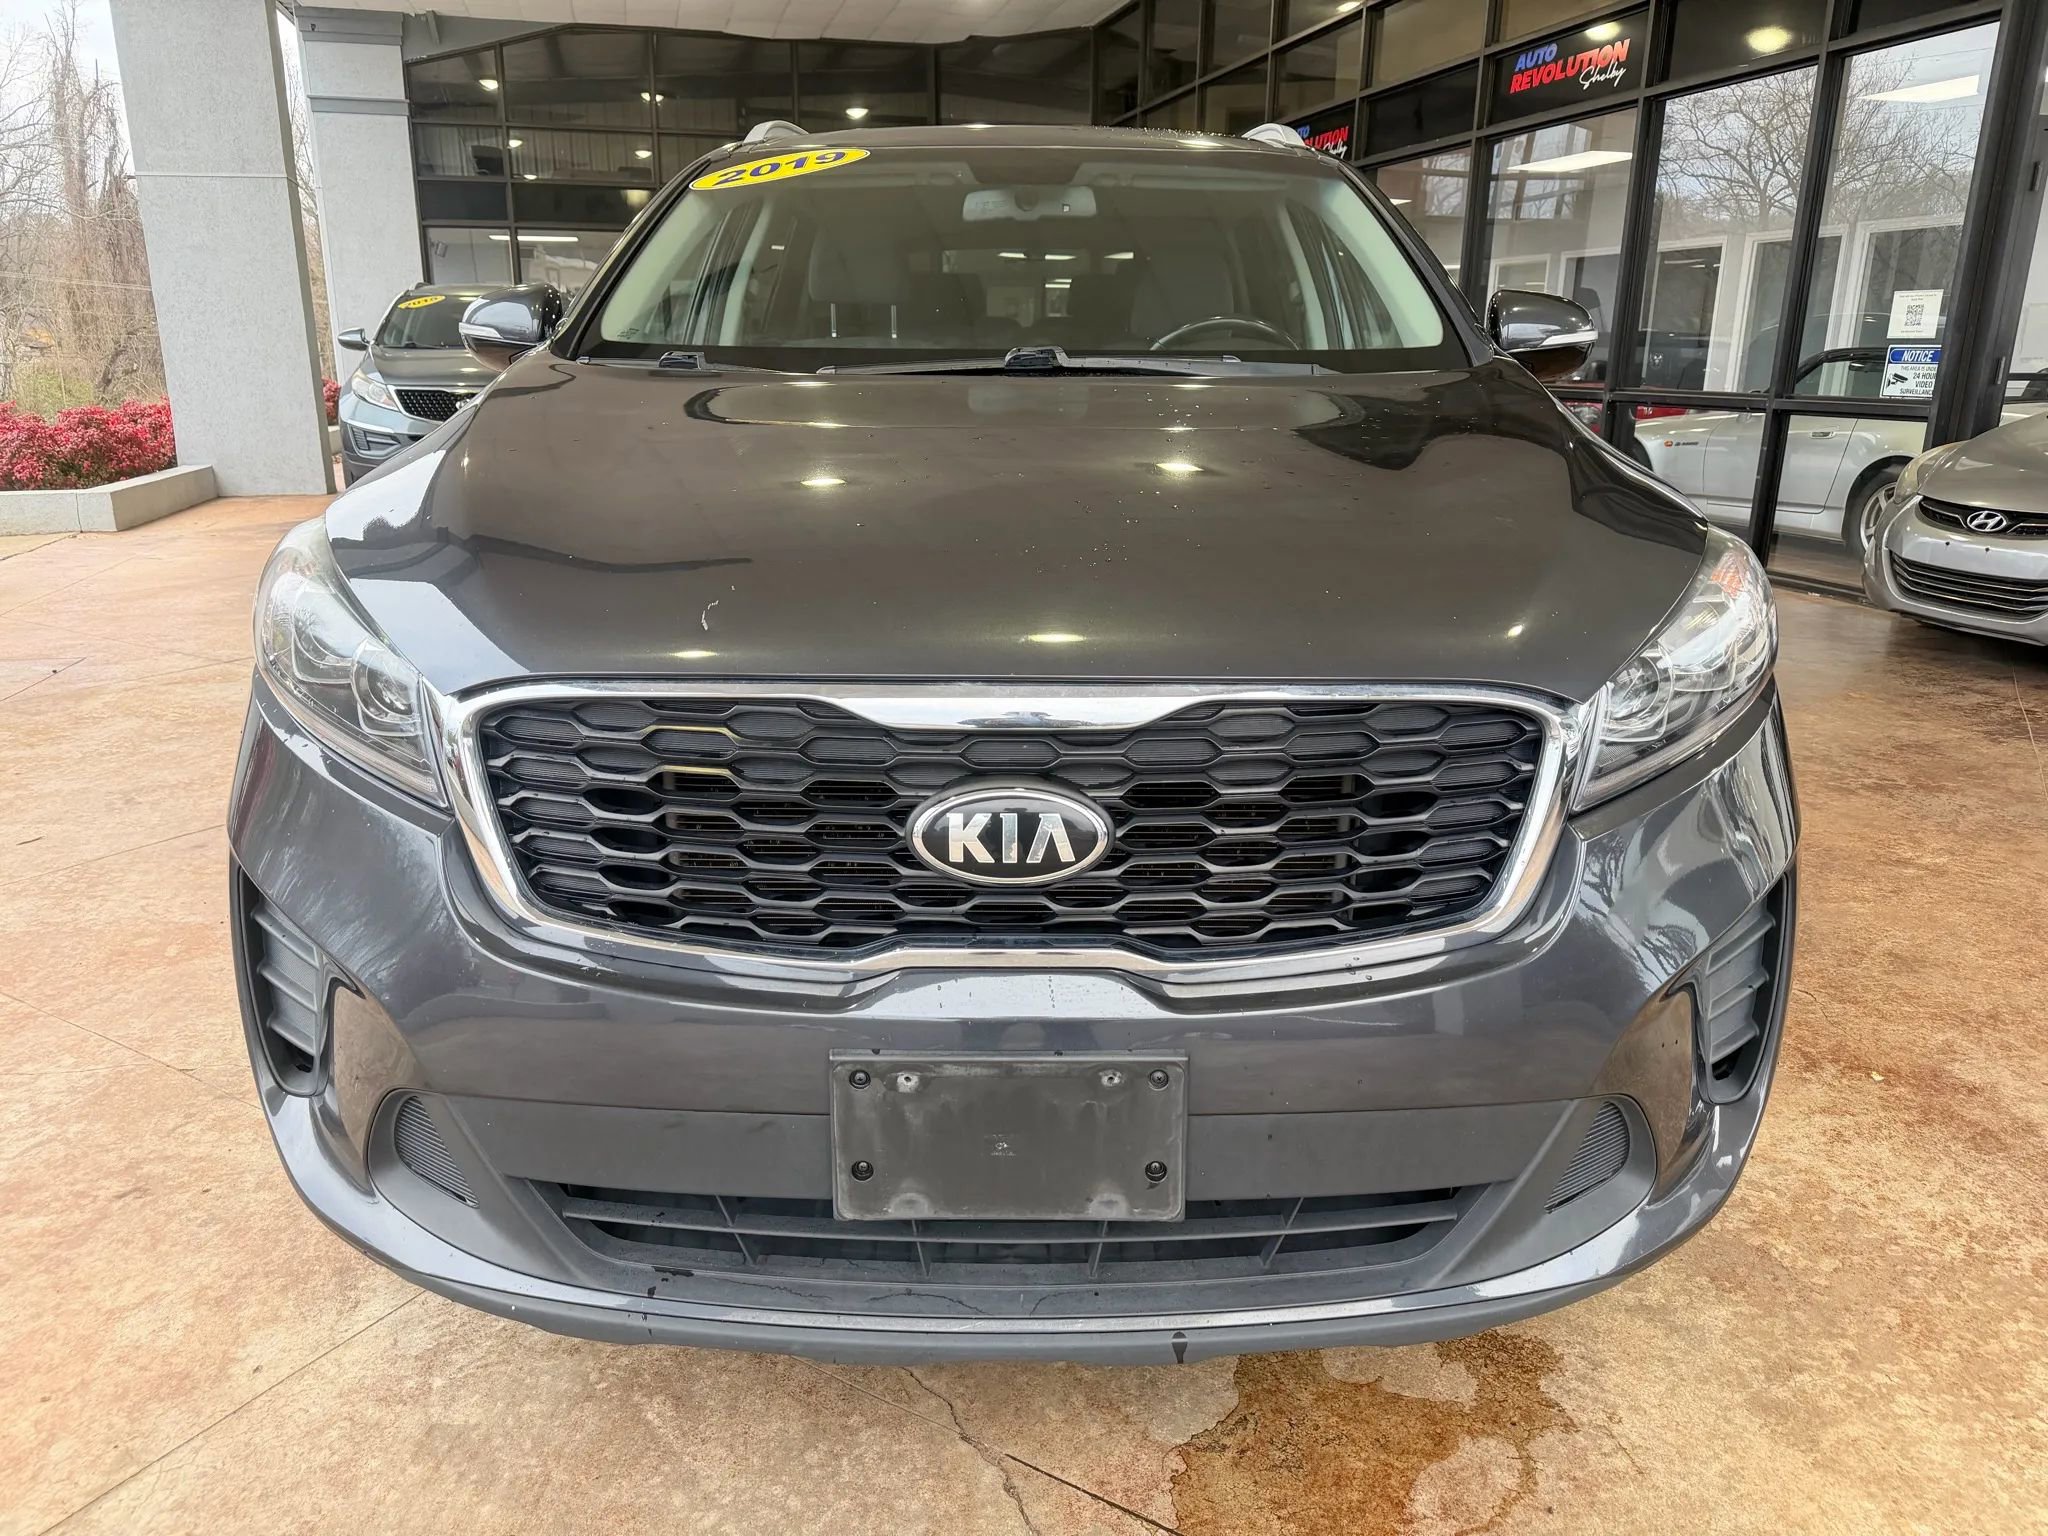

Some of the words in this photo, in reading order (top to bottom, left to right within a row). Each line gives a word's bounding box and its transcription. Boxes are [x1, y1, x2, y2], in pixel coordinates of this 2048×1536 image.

[1510, 38, 1631, 94] REVOLUTION
[1515, 43, 1558, 71] AUTO
[1579, 59, 1626, 90] Shelby
[712, 151, 846, 187] 2019
[1901, 350, 1935, 363] NOTICE
[1913, 372, 1920, 380] 24
[1915, 381, 1933, 389] VIDEO
[946, 812, 1076, 864] KIA
